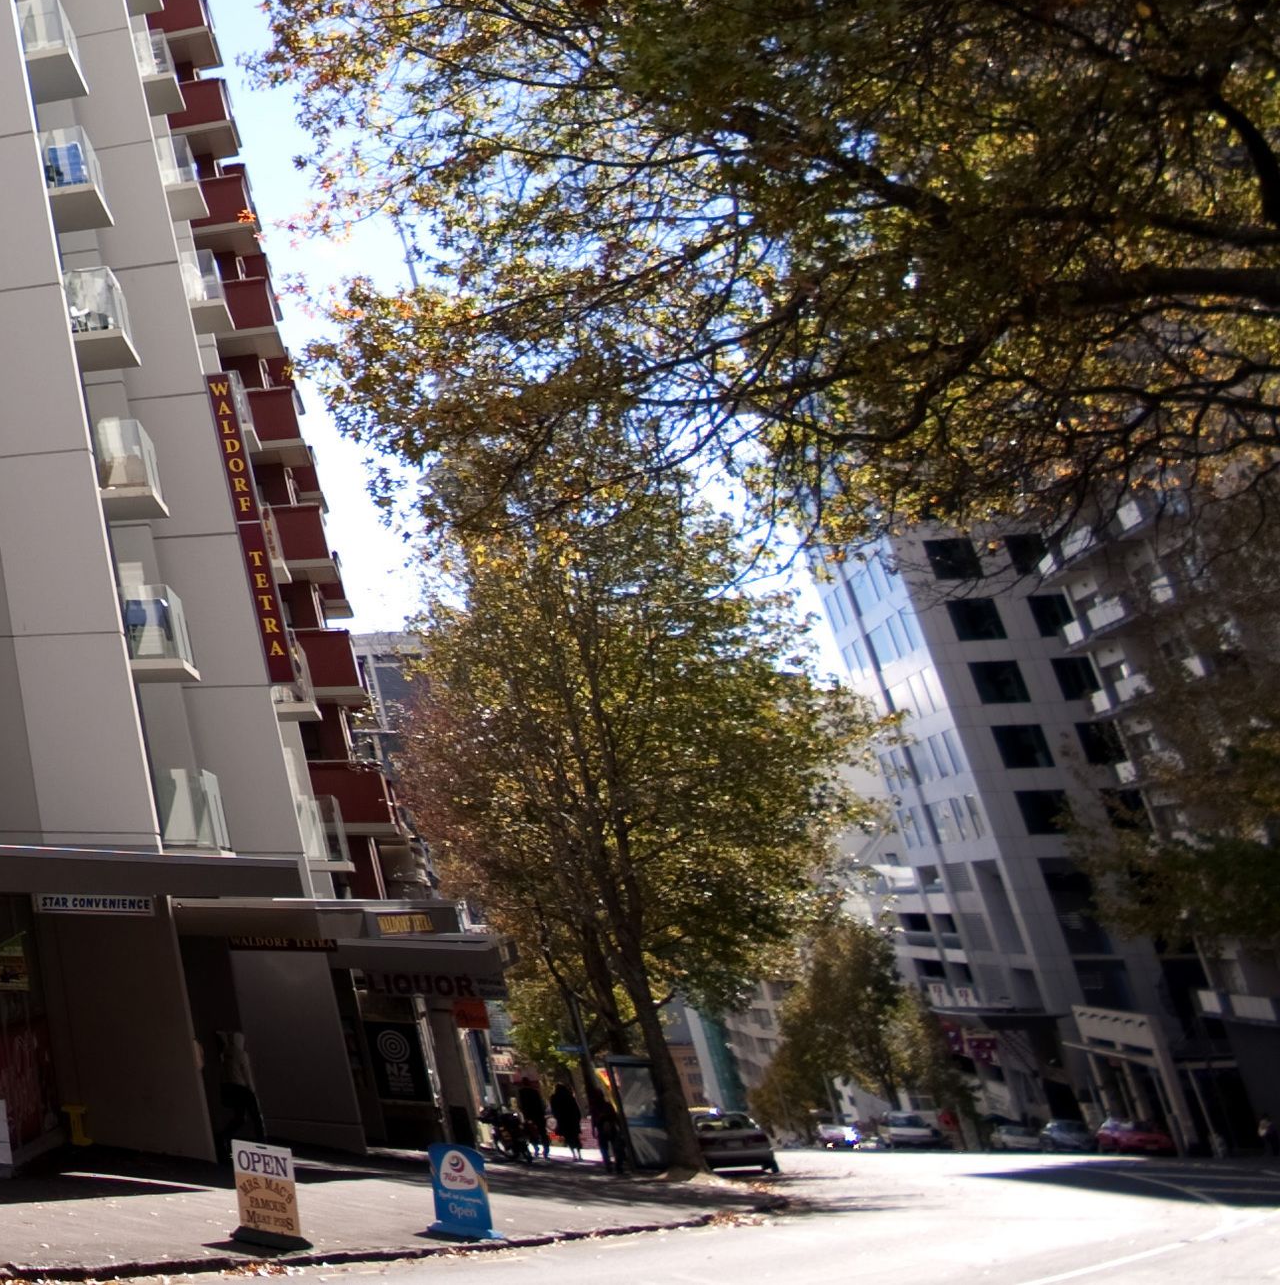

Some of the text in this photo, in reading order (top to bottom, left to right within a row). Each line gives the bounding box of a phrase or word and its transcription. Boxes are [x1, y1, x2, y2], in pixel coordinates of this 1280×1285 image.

[209, 381, 251, 513] WALDORF
[248, 550, 284, 657] TETRA
[42, 896, 151, 910] STAR CONVENIENCE
[229, 936, 336, 948] WALDORF TETRA
[368, 973, 476, 997] LIQUOR
[237, 1149, 288, 1178] OPEN
[443, 1172, 458, 1183] Tip
[249, 1196, 288, 1214] FAMOUS
[448, 1201, 478, 1219] Open
